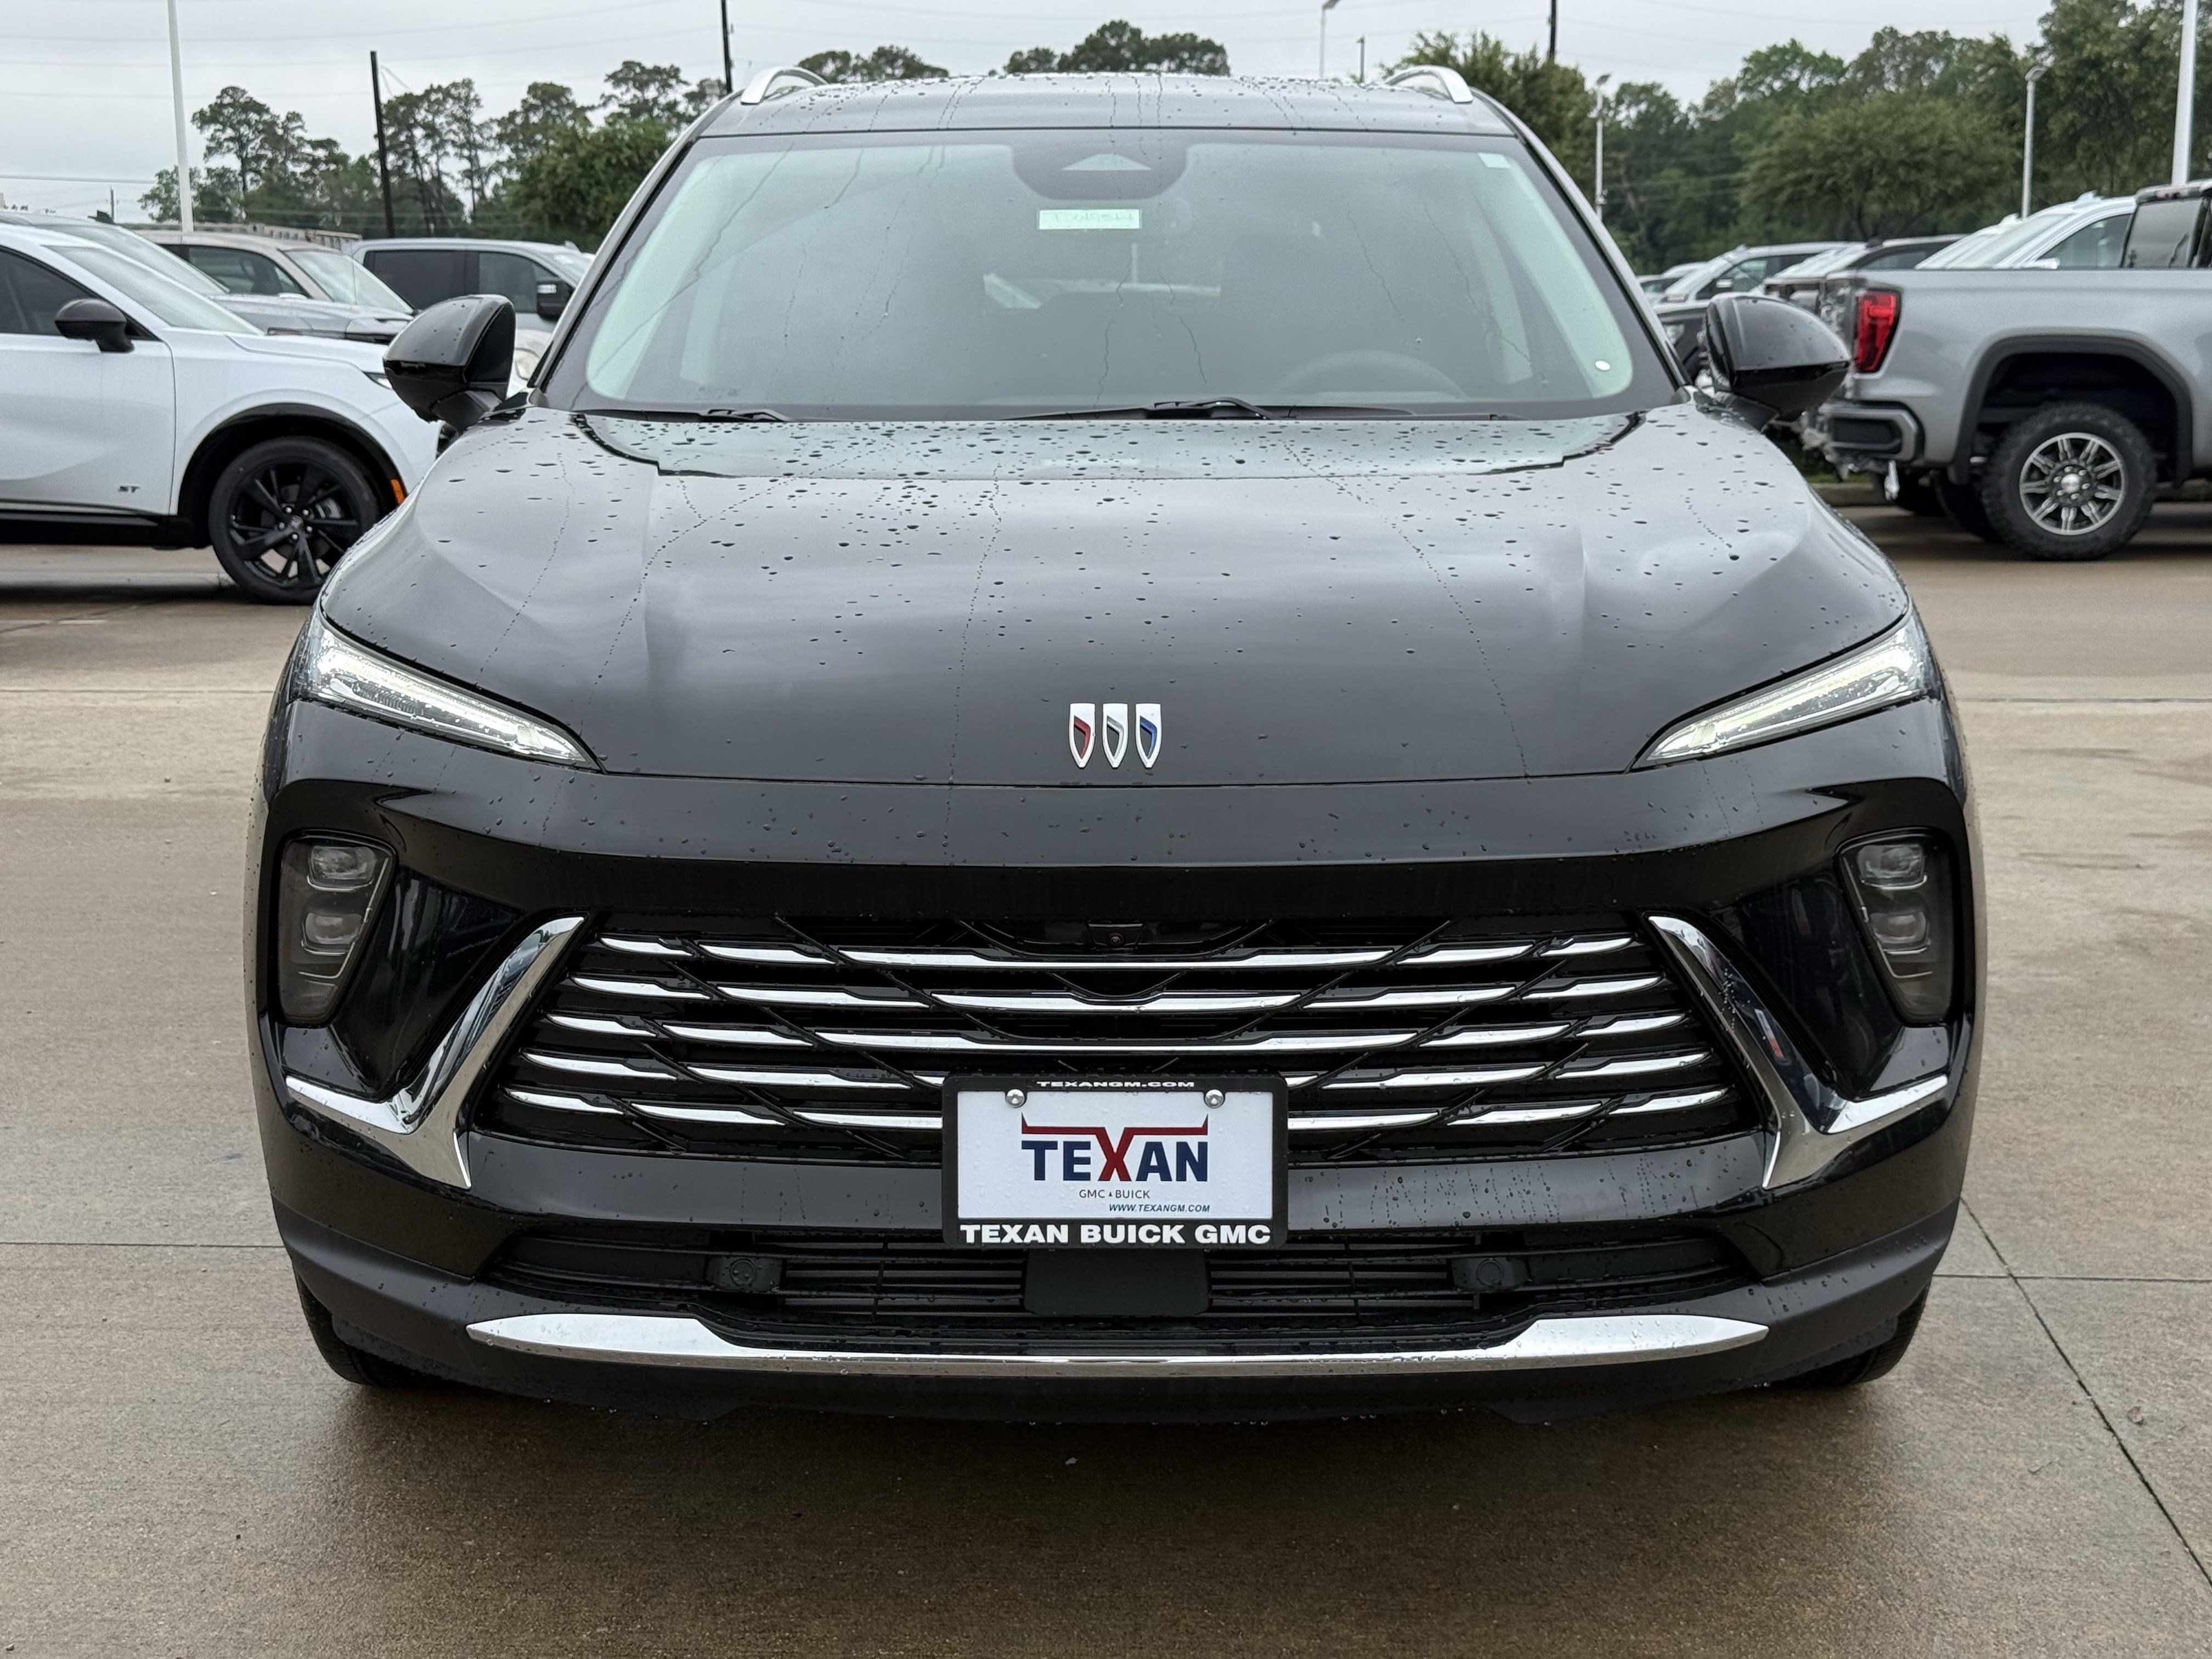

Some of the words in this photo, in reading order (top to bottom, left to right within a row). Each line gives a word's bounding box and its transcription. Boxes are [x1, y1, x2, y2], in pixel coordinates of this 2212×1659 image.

[117, 486, 140, 494] ST
[1021, 1126, 1208, 1181] TEXAN
[1079, 1189, 1105, 1199] GMC
[1115, 1189, 1150, 1199] BUICK
[1109, 1204, 1210, 1212] WWW.TEXANGM.COM
[960, 1224, 1069, 1243] TEXAN
[1080, 1224, 1186, 1244] BUICK
[1194, 1224, 1271, 1244] GMC
